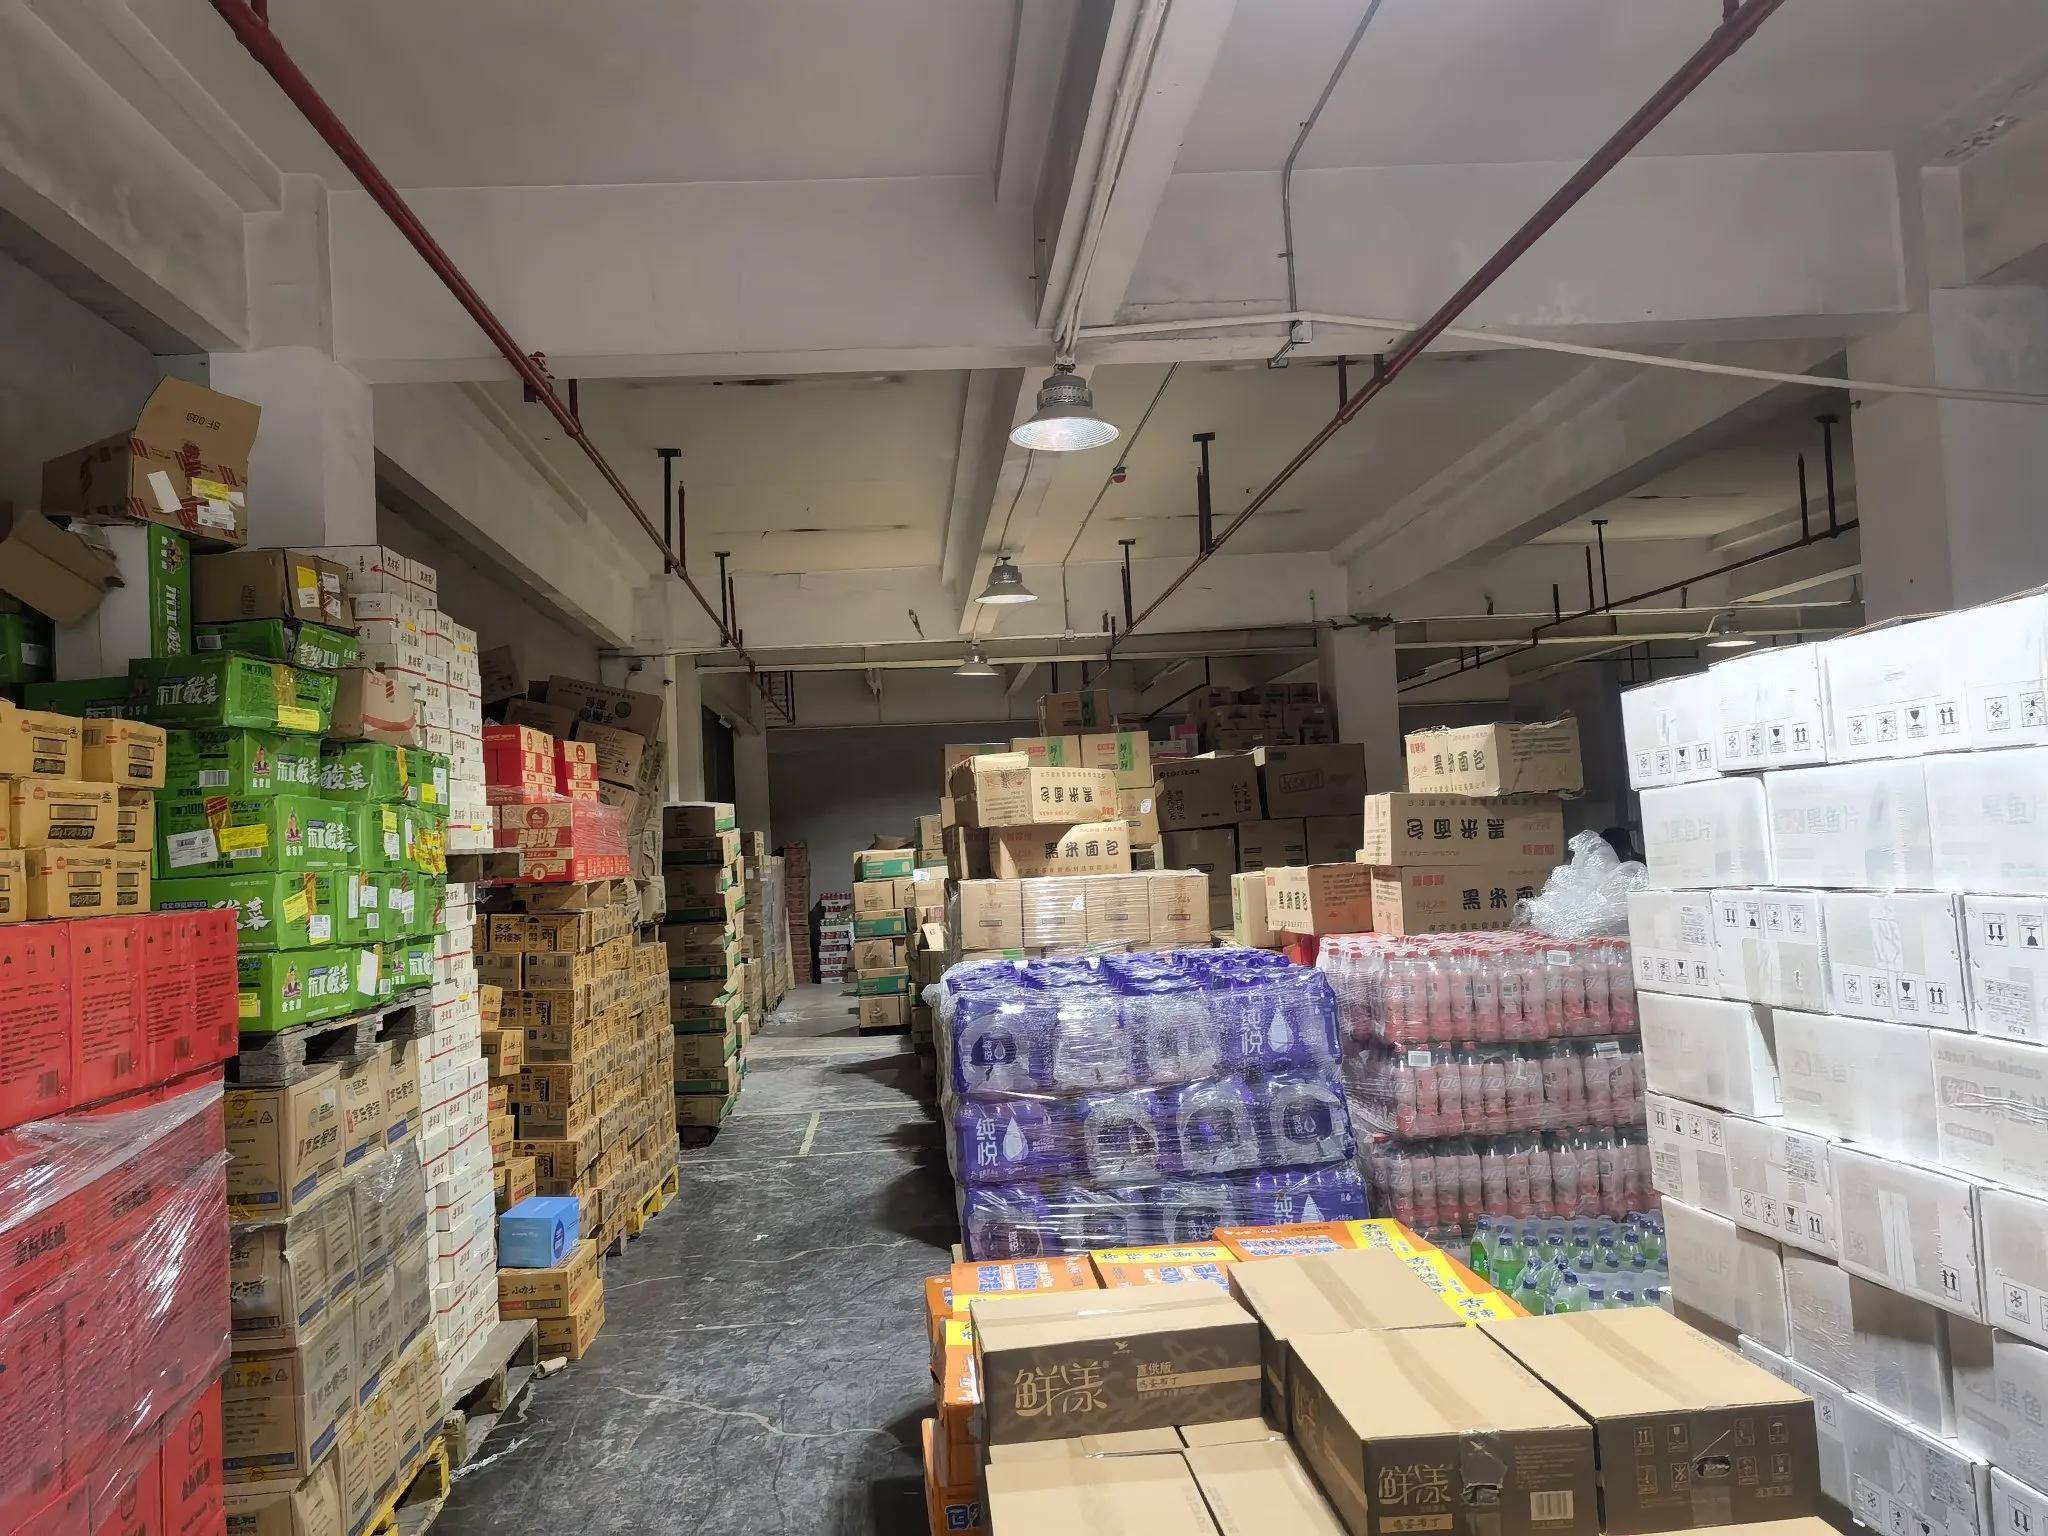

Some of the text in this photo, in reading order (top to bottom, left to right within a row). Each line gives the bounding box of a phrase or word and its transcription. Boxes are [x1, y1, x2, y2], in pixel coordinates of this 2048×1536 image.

[1433, 749, 1487, 776] 黑米面包
[1040, 786, 1095, 804] 黑米面包
[1407, 818, 1505, 840] 黑米面包
[1045, 839, 1119, 860] 黑米面包
[1242, 1010, 1263, 1055] 纯悦
[976, 1117, 999, 1167] 纯悦
[1273, 1194, 1294, 1224] 纯
[1014, 1360, 1109, 1417] 鲜漾
[1378, 1463, 1453, 1506] 鲜漾
